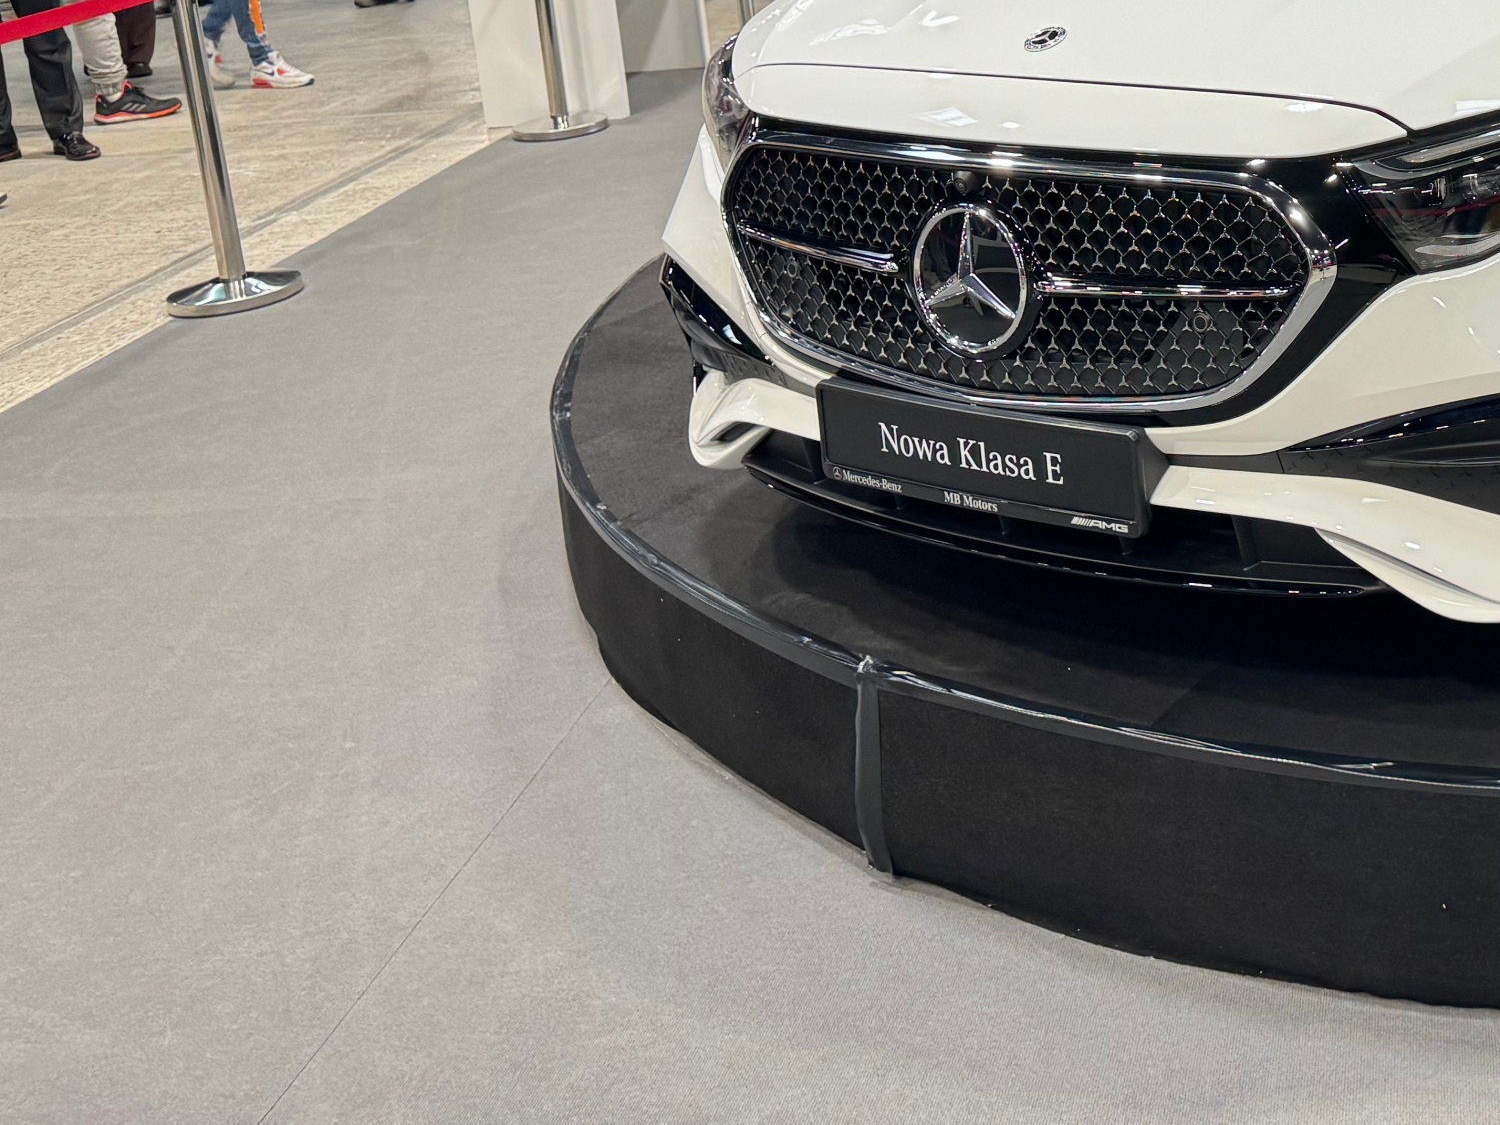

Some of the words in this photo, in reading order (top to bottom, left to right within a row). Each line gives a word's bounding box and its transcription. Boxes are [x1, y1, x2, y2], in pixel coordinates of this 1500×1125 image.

[878, 421, 951, 466] Nowa
[956, 437, 1037, 482] Klasa
[1043, 451, 1064, 486] E
[842, 469, 902, 493] Mercedes-Benz
[943, 491, 961, 505] MB
[963, 495, 998, 513] Motors
[1089, 519, 1129, 534] AMG
